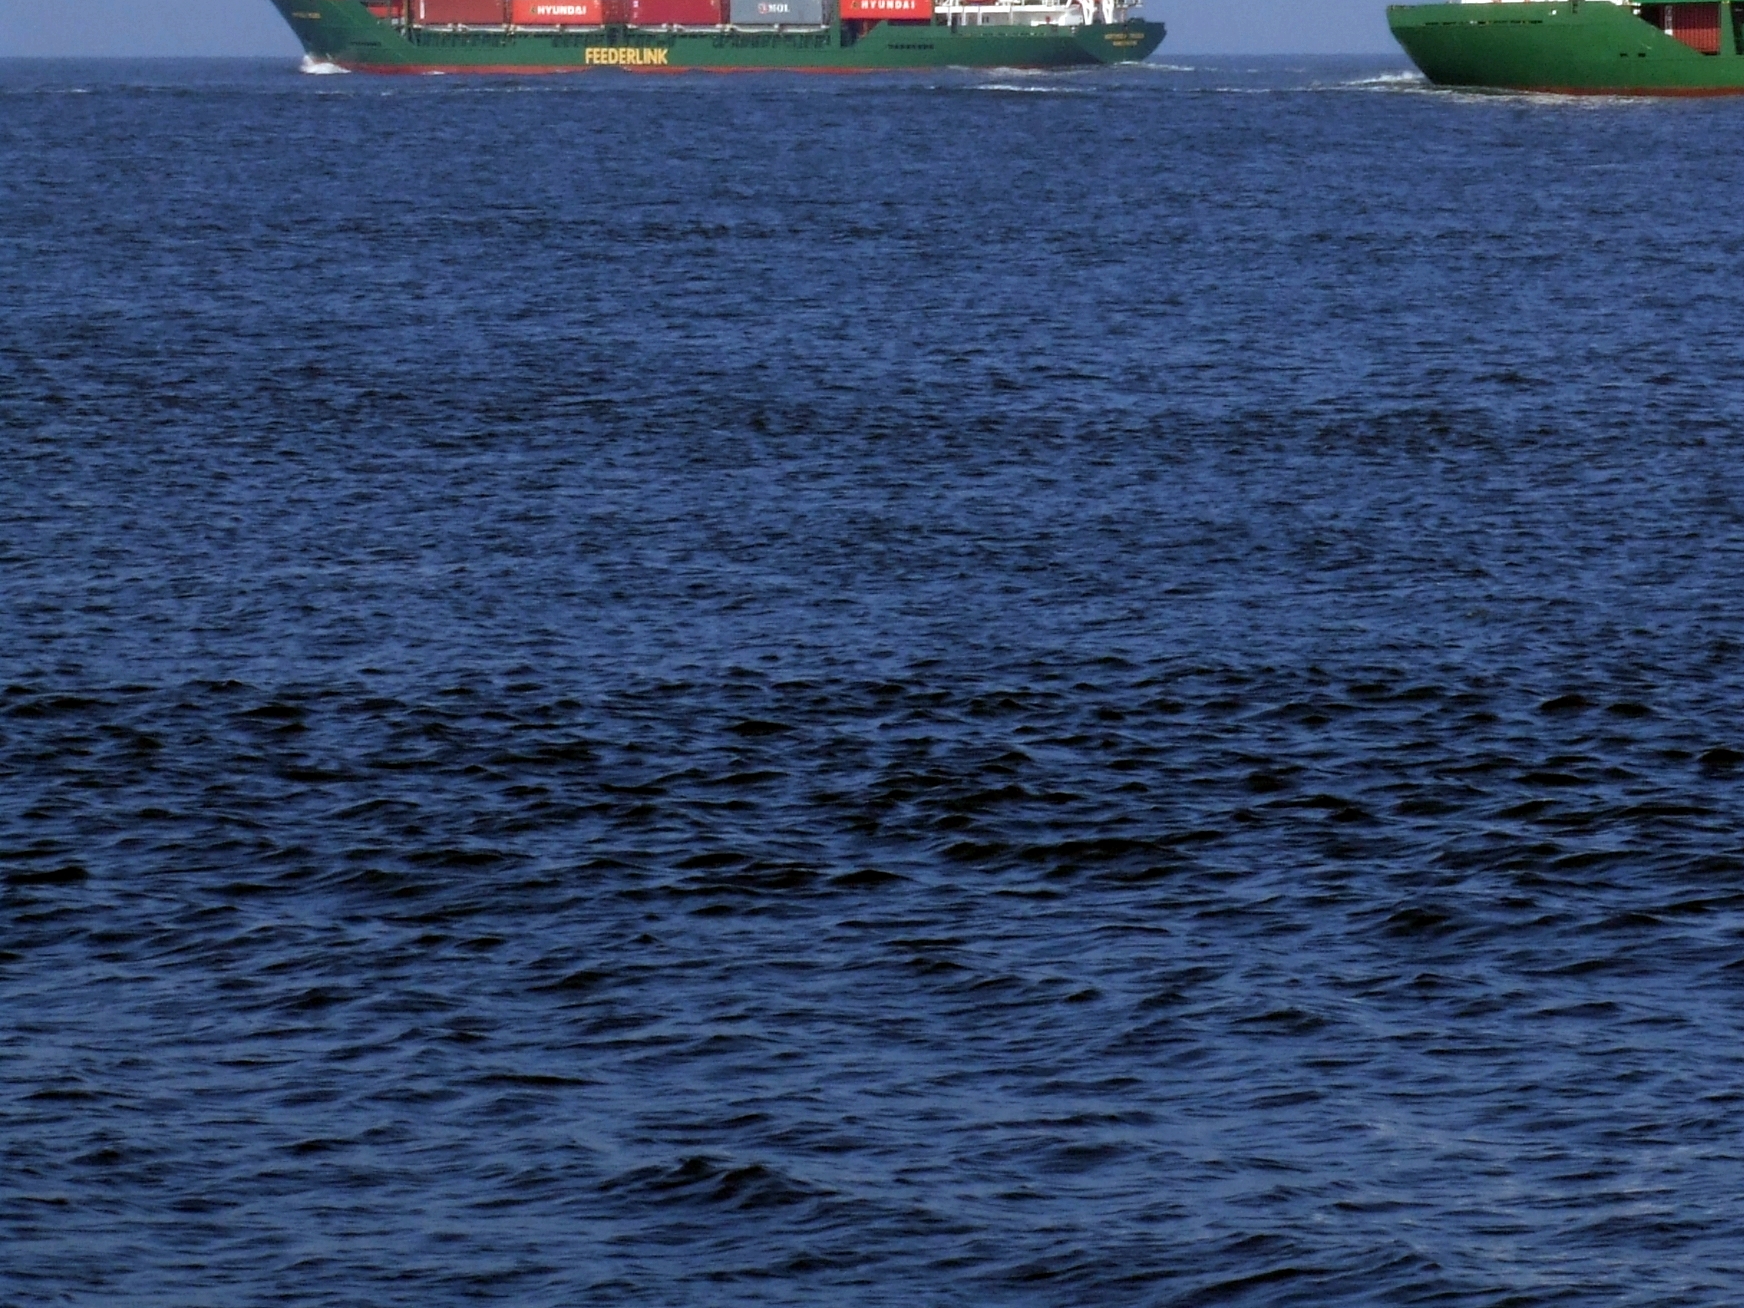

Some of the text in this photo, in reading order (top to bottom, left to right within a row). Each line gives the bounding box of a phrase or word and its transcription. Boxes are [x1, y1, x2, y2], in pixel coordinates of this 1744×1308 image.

[537, 5, 587, 15] HYUNDAI
[768, 3, 790, 13] MOL
[861, 0, 915, 10] HYUNDAI
[585, 47, 668, 65] FEEDERLINK
